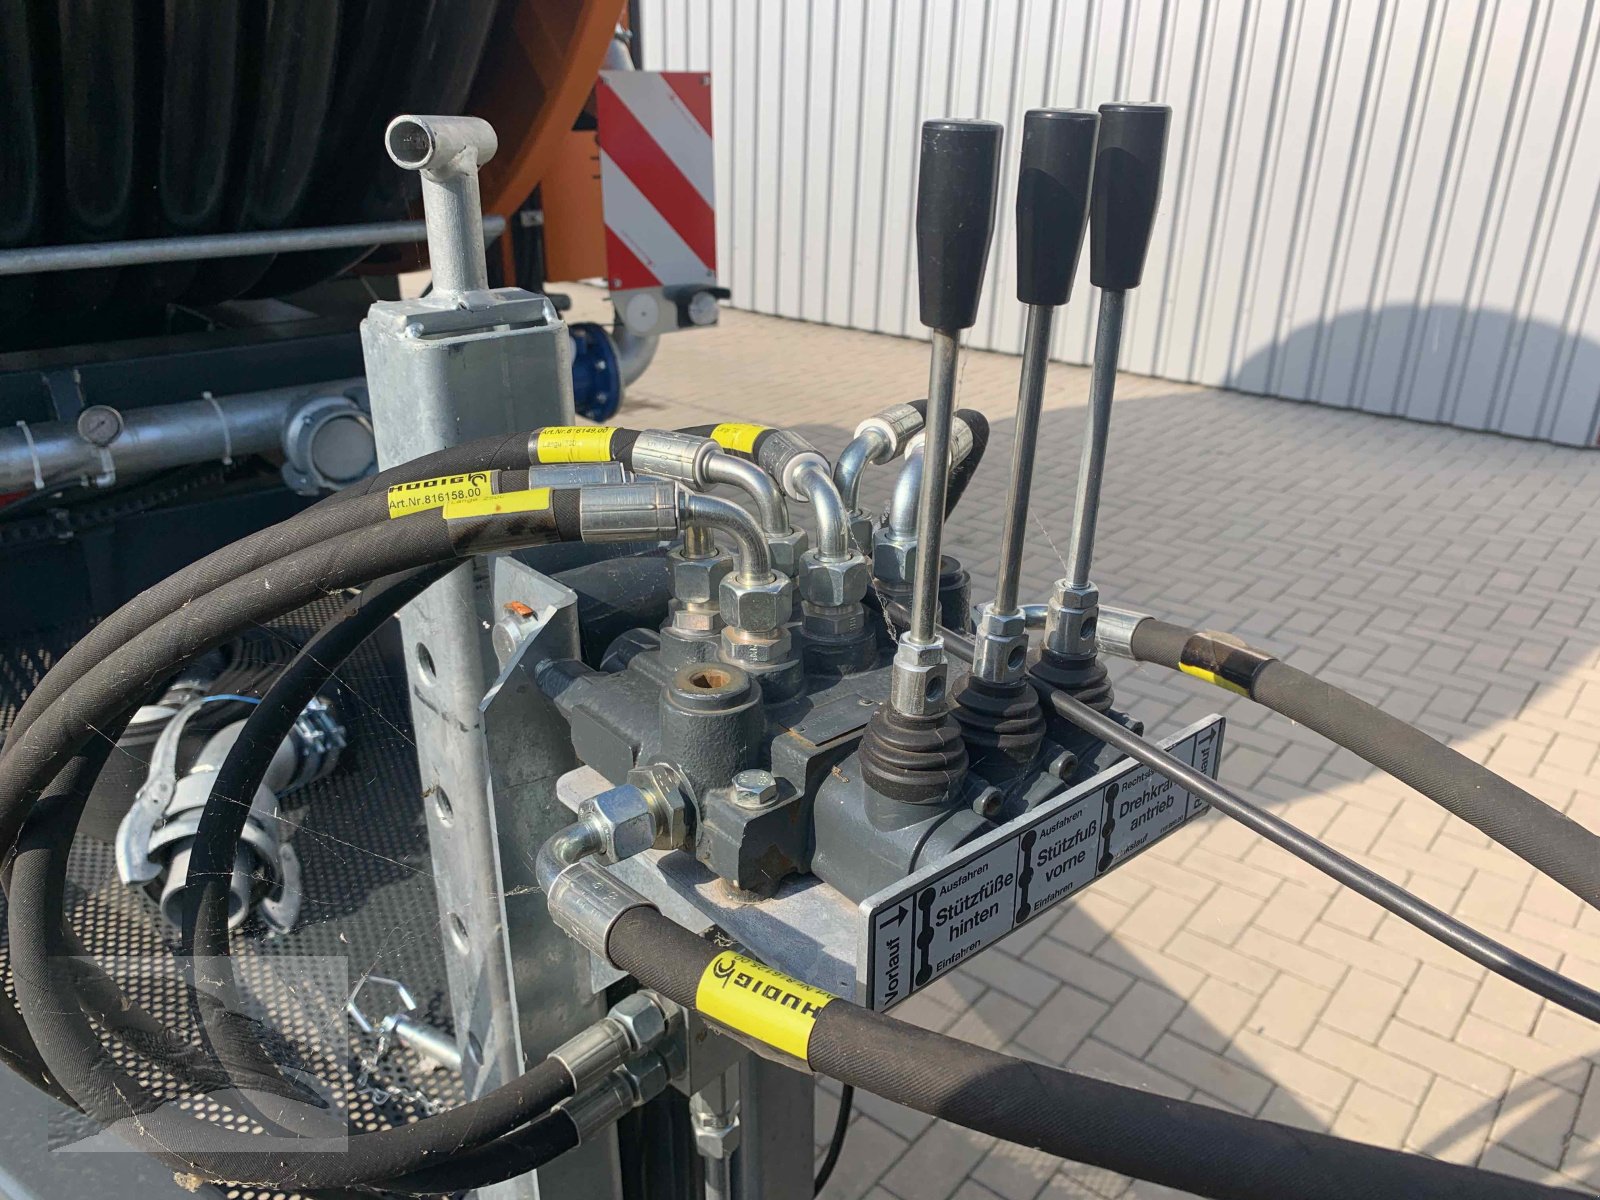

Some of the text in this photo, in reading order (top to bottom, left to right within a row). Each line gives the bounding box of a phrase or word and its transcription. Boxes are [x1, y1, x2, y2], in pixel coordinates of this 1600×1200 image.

[388, 475, 465, 493] HUDIG
[389, 487, 481, 509] Art.Nr.816158.00
[1039, 809, 1083, 840] Ausfahren
[1130, 794, 1175, 831] antrieb
[1036, 819, 1097, 867] Stützfuß
[938, 863, 989, 897] Ausfahren
[1045, 850, 1086, 882] vorne
[935, 872, 1014, 927] Stützfüße
[1033, 881, 1074, 911] Einfahren
[949, 902, 999, 942] hinten
[884, 936, 900, 1006] Vorlauf
[936, 939, 981, 973] Einfahren
[734, 972, 823, 1019] HUDIG
